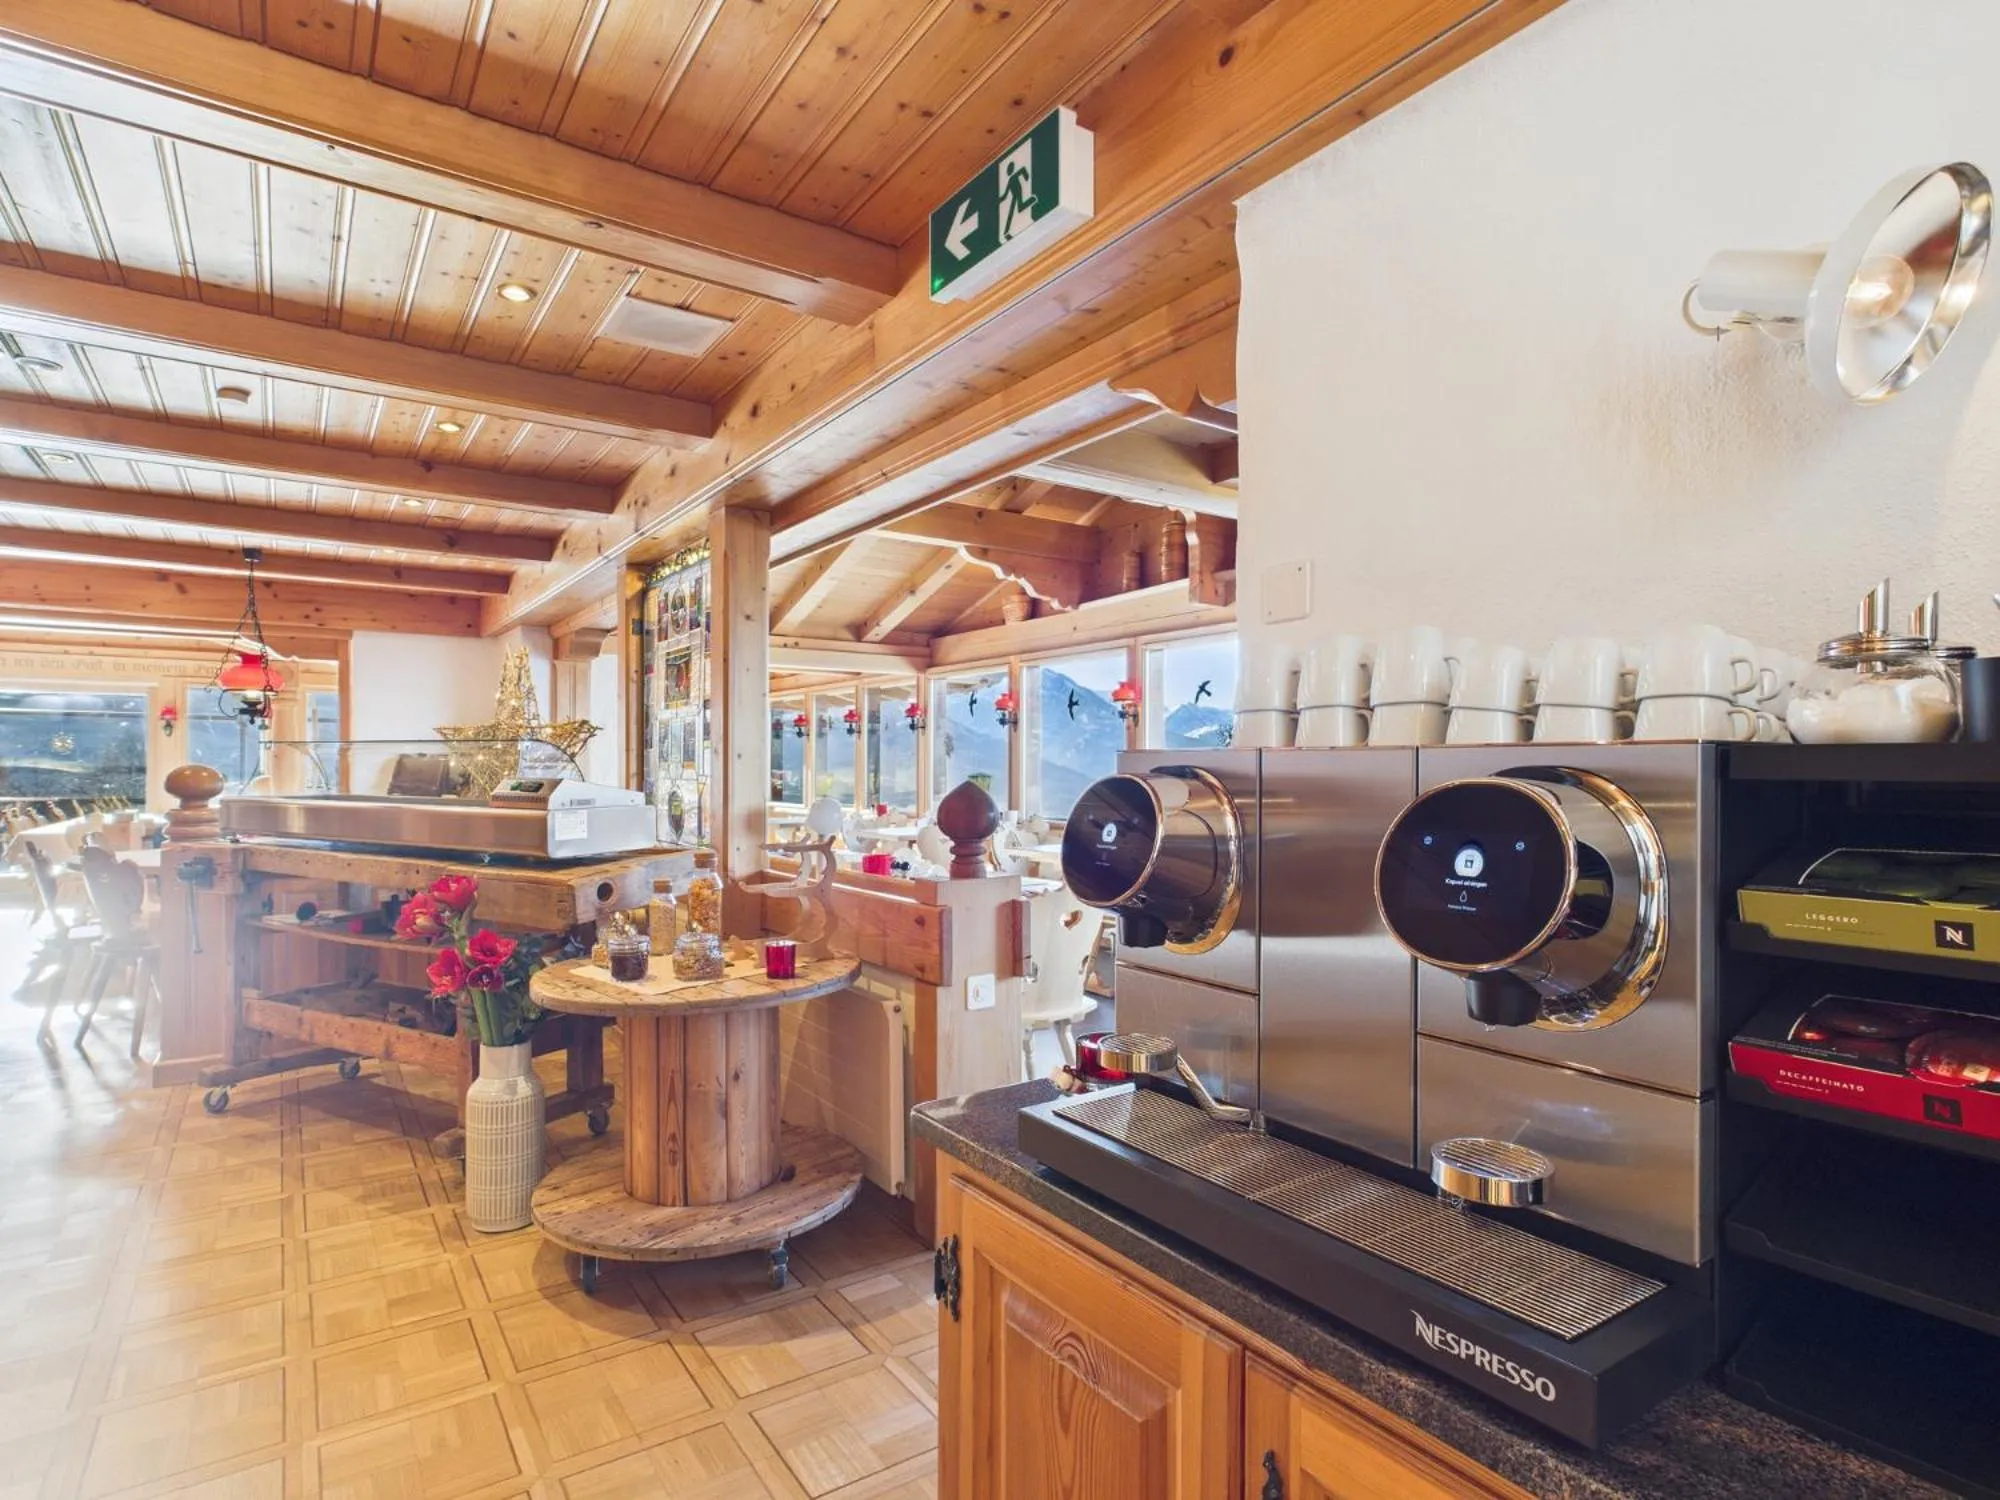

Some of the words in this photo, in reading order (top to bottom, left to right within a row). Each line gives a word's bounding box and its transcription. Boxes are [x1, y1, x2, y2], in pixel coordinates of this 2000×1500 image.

[1805, 912, 1859, 924] LEGGERO
[1779, 1068, 1865, 1092] DECAFFEINATO
[1410, 1309, 1557, 1403] NESPRESSO
